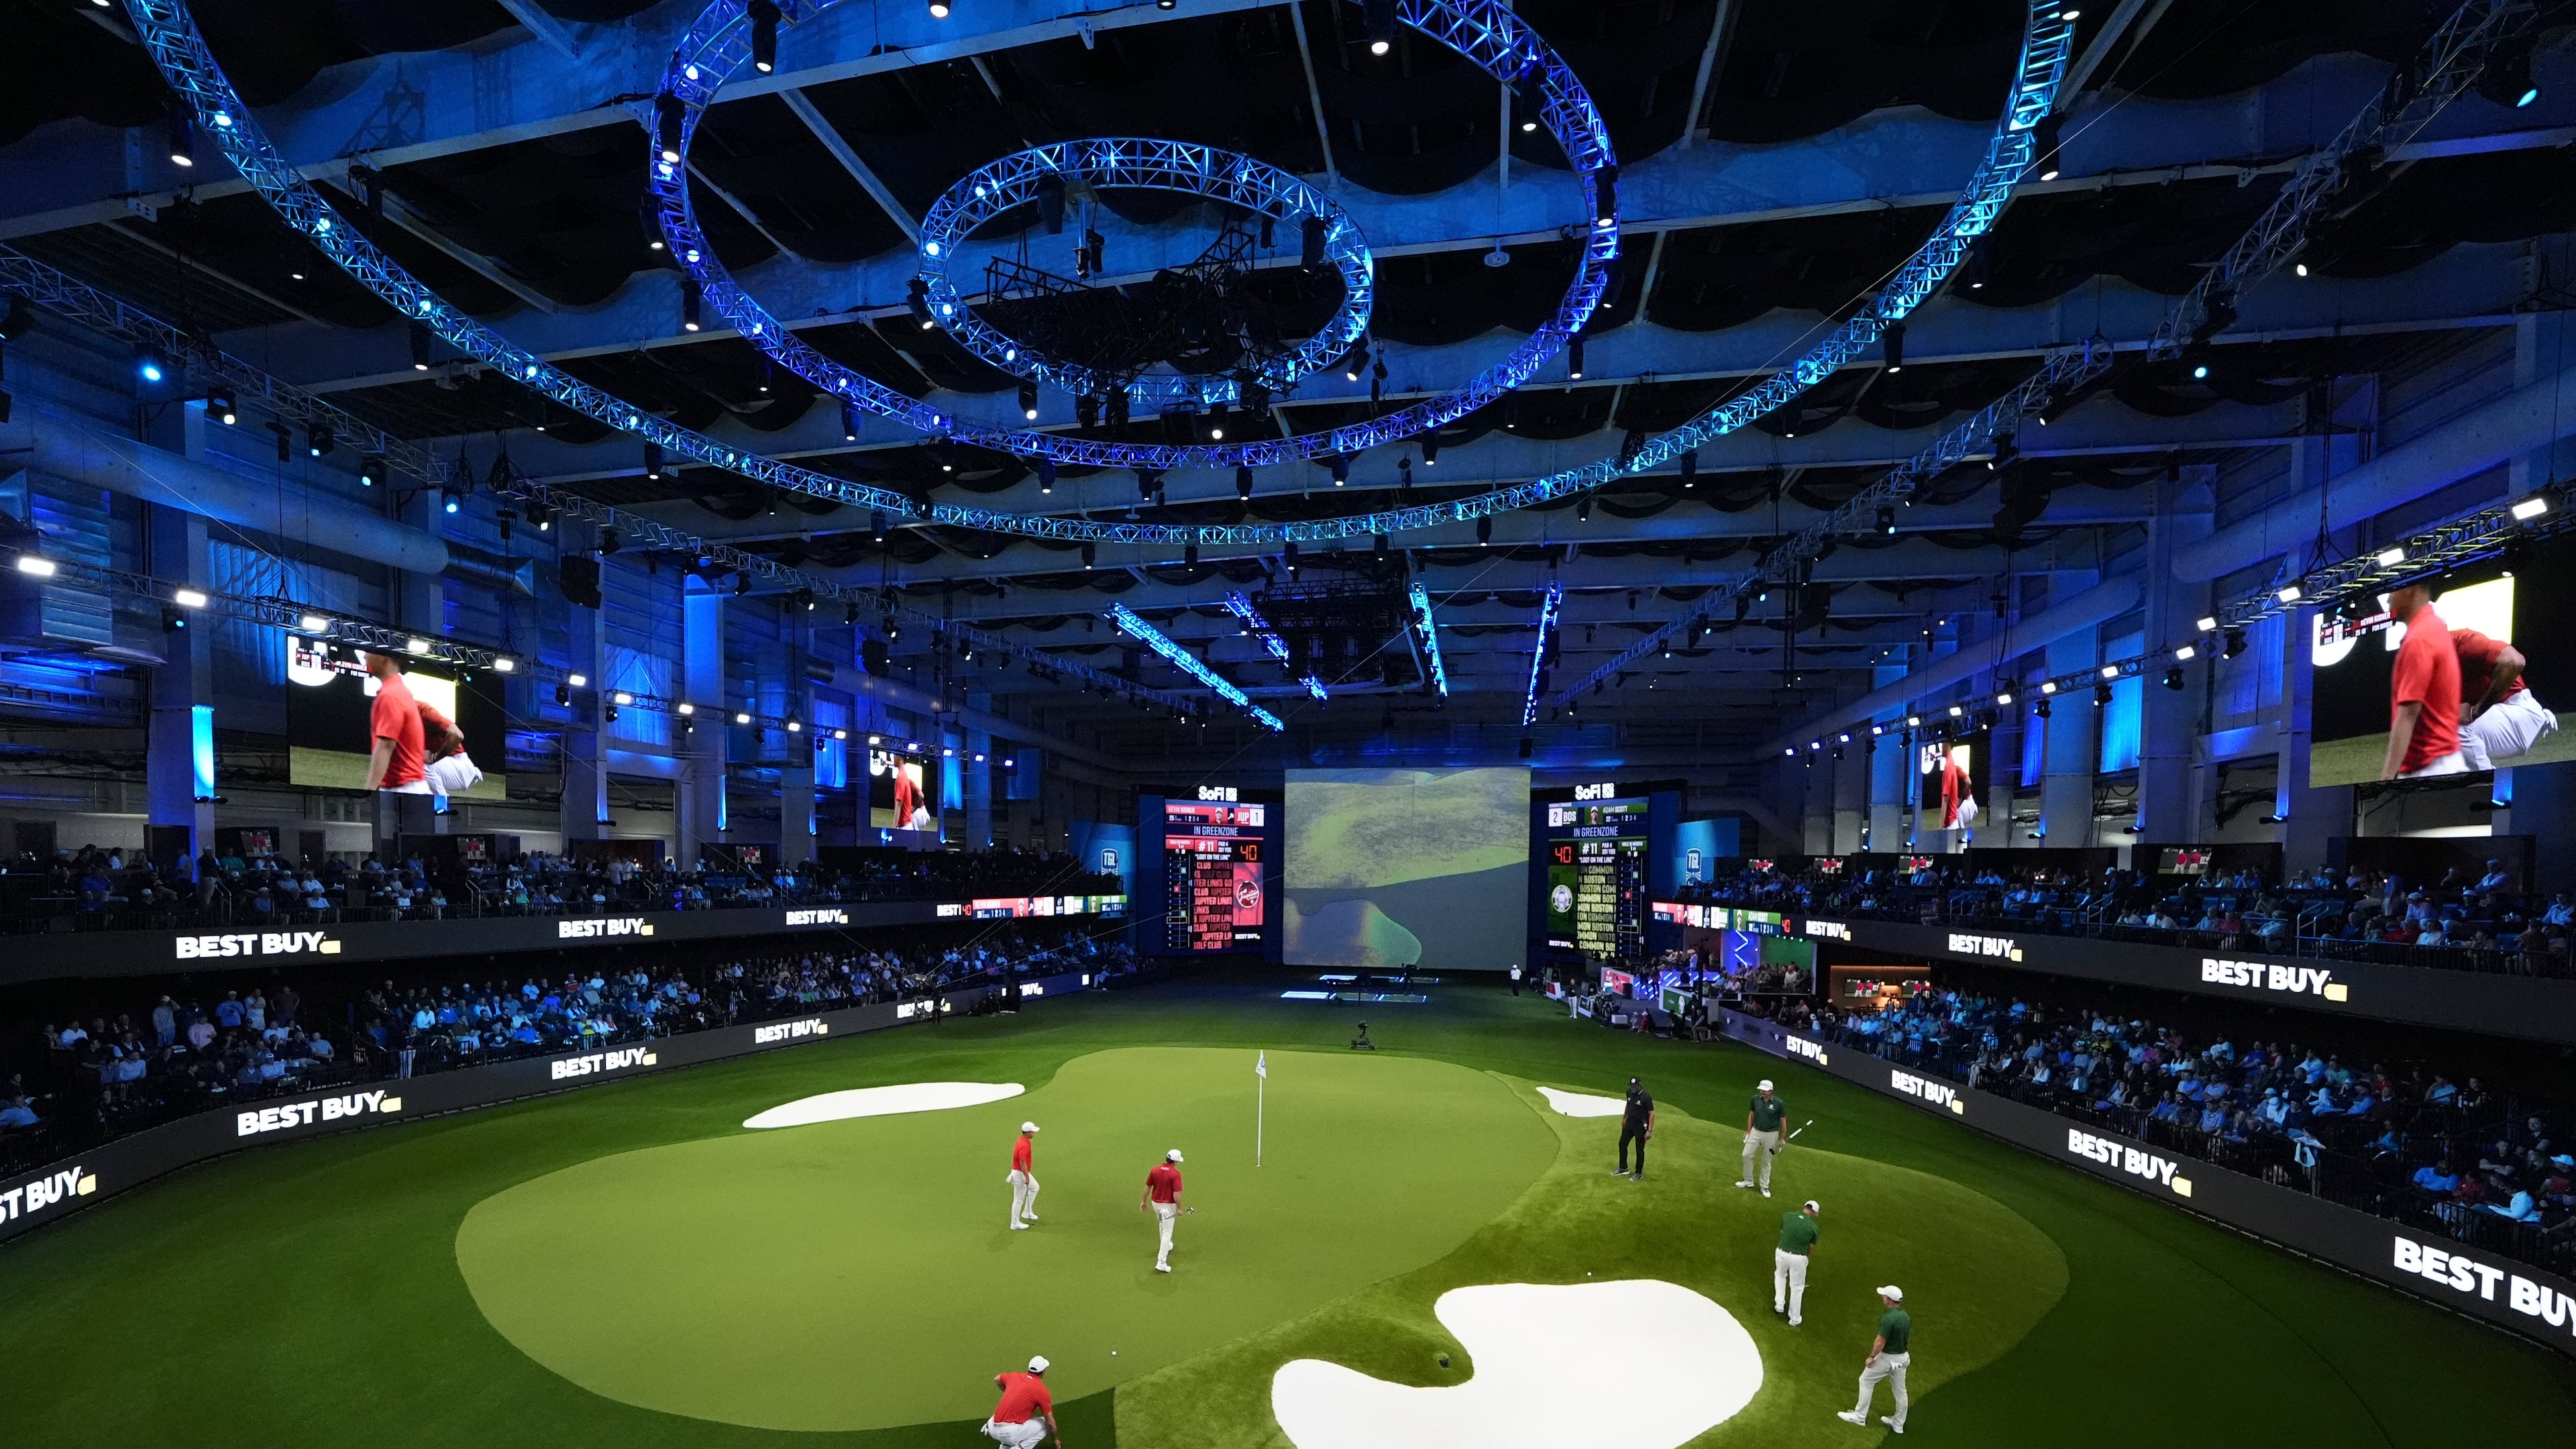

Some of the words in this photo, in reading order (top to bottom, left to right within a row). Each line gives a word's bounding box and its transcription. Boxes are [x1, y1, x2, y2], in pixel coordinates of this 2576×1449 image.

[1198, 786, 1225, 801] SoFi
[1575, 784, 1601, 800] SoFi
[1237, 811, 1250, 822] JUP
[1563, 810, 1576, 822] BOS
[1194, 825, 1201, 835] IN
[1201, 826, 1238, 837] GREENZONE
[1573, 827, 1580, 837] IN
[1581, 826, 1618, 837] GREENZONE
[1198, 841, 1214, 852] #11
[1240, 845, 1257, 861] 40
[1582, 843, 1598, 855] #11
[1104, 853, 1116, 866] TGL
[1555, 846, 1571, 863] 40
[1688, 853, 1699, 869] TGL
[1589, 865, 1613, 874] COMMON
[1208, 879, 1223, 887] LINKS
[1584, 875, 1605, 883] BOSTON
[1194, 888, 1209, 896] CLUB
[1580, 884, 1601, 893] BOSTON
[1195, 897, 1217, 905] JUPITER
[937, 904, 959, 916] BEST
[963, 905, 971, 916] 40
[1591, 904, 1613, 913] BOSTON
[786, 910, 816, 925] BEST
[817, 909, 843, 923] BUY
[1198, 914, 1220, 923] JUPITER
[1588, 913, 1613, 922] COMMON
[559, 919, 605, 938] BEST
[608, 918, 639, 935] BUY
[1592, 922, 1613, 932] BOSTON
[1782, 918, 1790, 933] 40
[1806, 920, 1827, 937] BEST
[1827, 922, 1845, 939] BUY
[1201, 932, 1224, 941] JUPITER
[176, 934, 258, 959] BEST
[262, 931, 324, 954] BUY
[1208, 941, 1222, 949] CLUB
[1579, 941, 1604, 951] COMMON
[1949, 933, 1982, 953] BEST
[1982, 937, 2013, 957] BUY
[2202, 958, 2265, 987] BEST
[2268, 965, 2329, 994] BUY
[1022, 982, 1039, 996] BUY
[755, 1023, 791, 1044] BEST
[792, 1018, 819, 1037] BUY
[1786, 1034, 1803, 1054] EST
[1802, 1040, 1823, 1061] BUY
[552, 1053, 603, 1080] BEST
[605, 1046, 645, 1071] BUY
[1892, 1069, 1925, 1097] BEST
[1925, 1080, 1955, 1108] BUY
[237, 1100, 319, 1136] BEST
[322, 1089, 384, 1121] BUY
[2068, 1128, 2123, 1167] BEST
[2125, 1147, 2177, 1185] BUY
[26, 1165, 82, 1213] BUY
[2394, 1236, 2504, 1301] BEST
